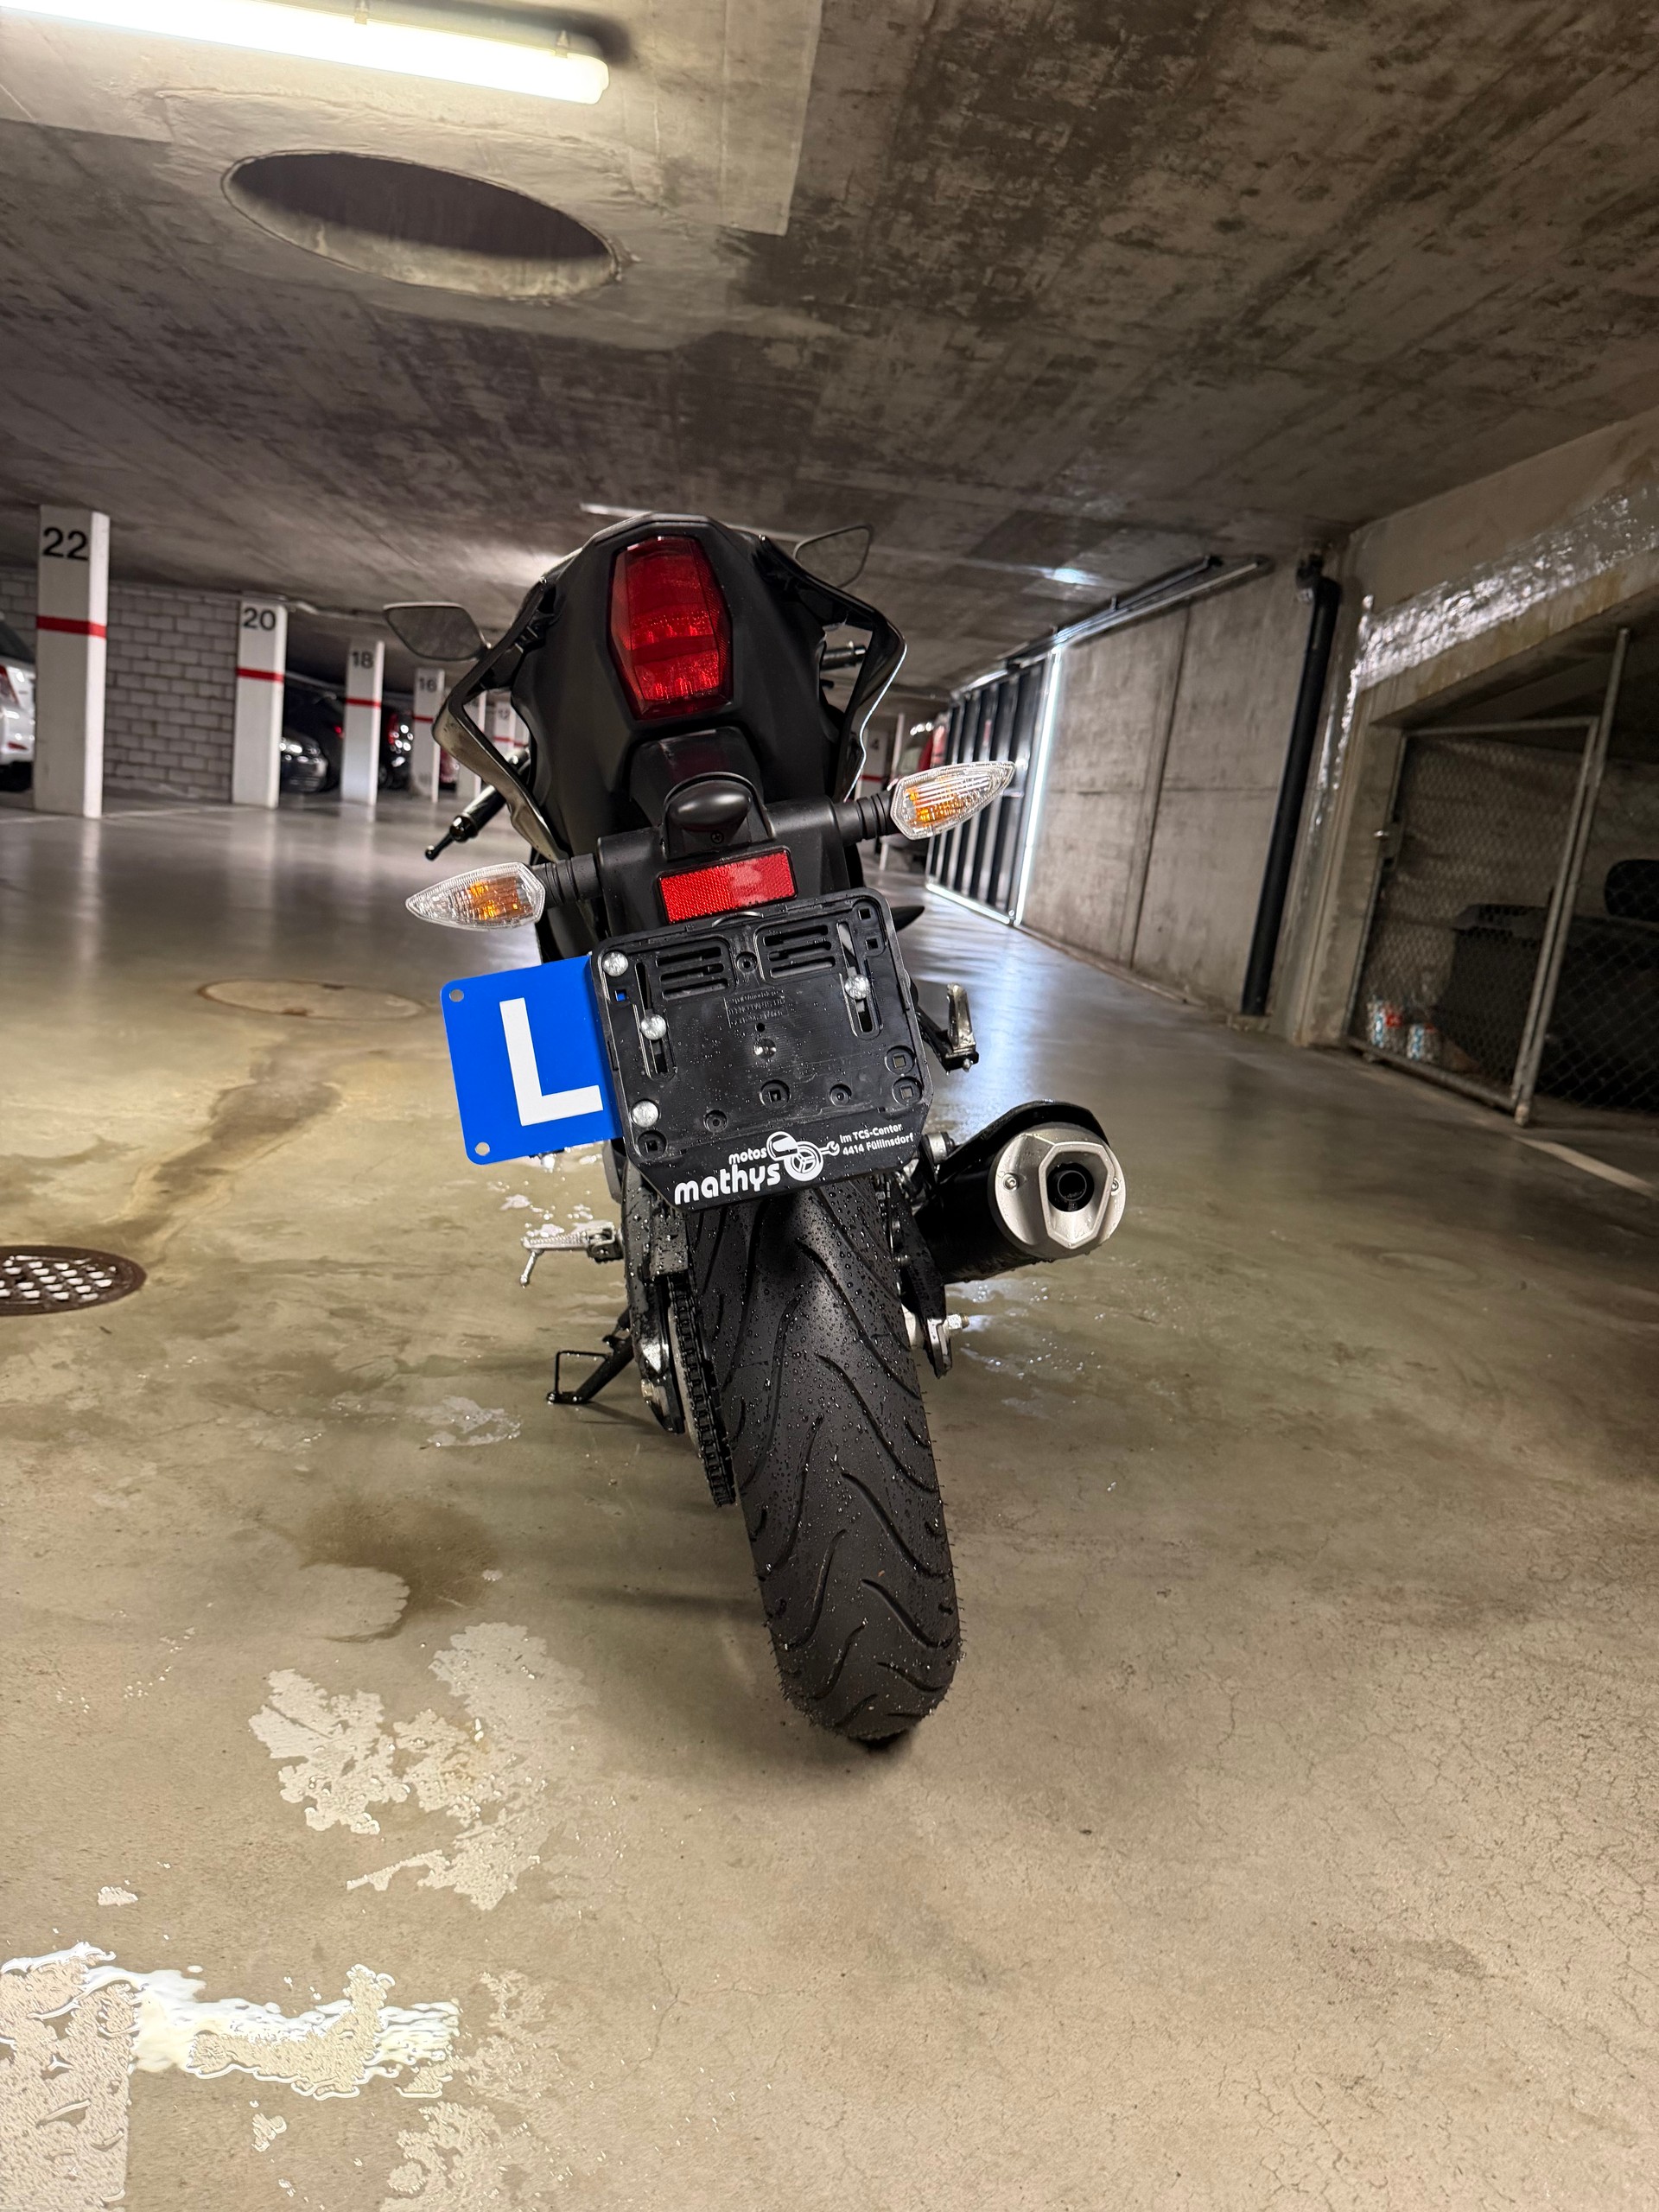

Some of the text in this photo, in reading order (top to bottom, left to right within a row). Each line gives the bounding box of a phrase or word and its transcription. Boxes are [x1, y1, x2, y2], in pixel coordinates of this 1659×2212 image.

[42, 527, 89, 562] 22
[243, 607, 276, 631] 20
[353, 651, 374, 670] 18
[419, 677, 437, 693] 16
[499, 997, 604, 1127] L
[728, 1147, 768, 1165] motos
[842, 1143, 865, 1156] 4414
[674, 1163, 781, 1205] mathys
